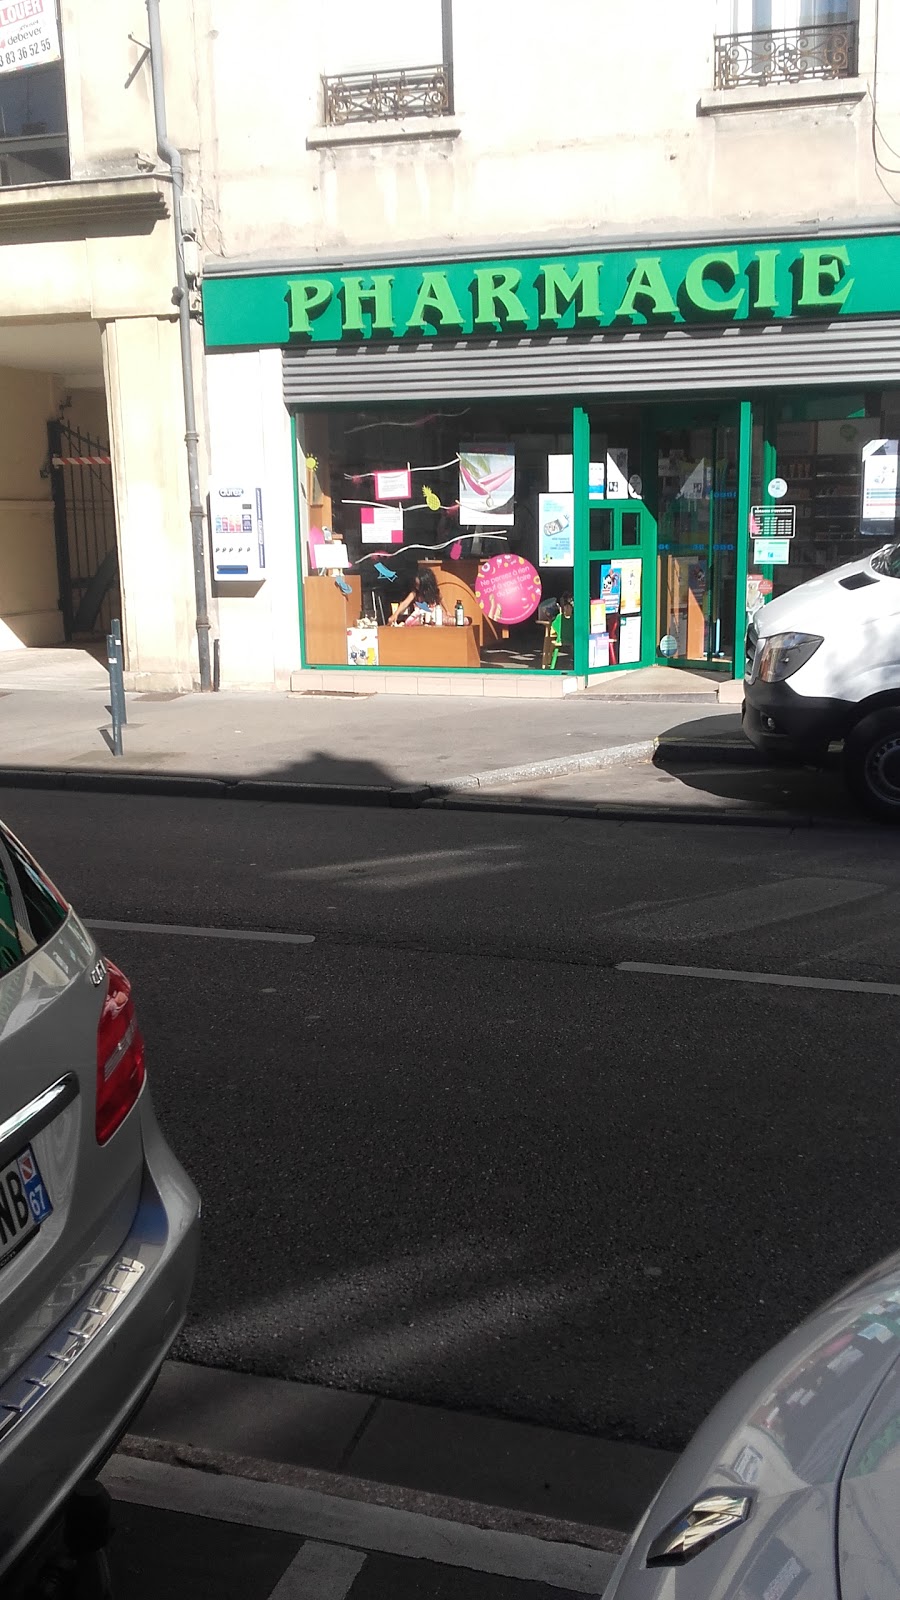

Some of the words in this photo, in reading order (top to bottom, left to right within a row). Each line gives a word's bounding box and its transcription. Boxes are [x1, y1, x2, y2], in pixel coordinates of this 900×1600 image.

[0, 0, 42, 26] LOUER
[7, 26, 42, 46] debever
[5, 50, 16, 65] 83
[17, 46, 28, 61] 36
[28, 42, 40, 57] 52
[40, 37, 51, 52] 55
[287, 244, 854, 334] PHARMACIE
[29, 1183, 46, 1216] 67
